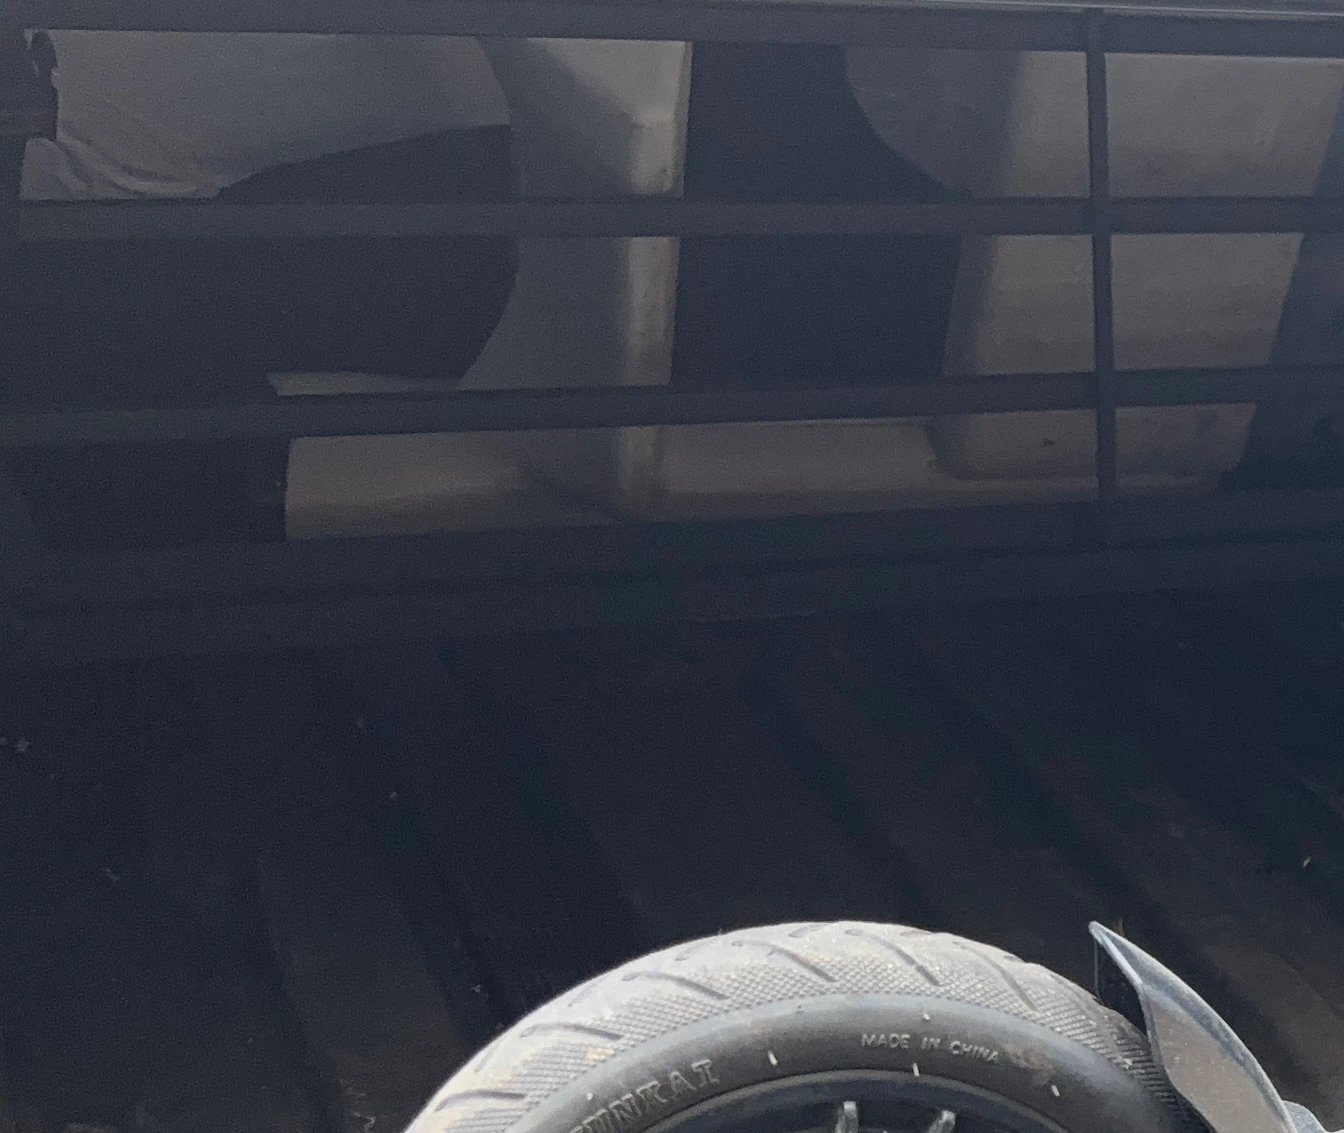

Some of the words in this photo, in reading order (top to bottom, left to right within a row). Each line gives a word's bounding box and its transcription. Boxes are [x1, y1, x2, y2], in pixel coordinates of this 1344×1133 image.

[861, 1033, 911, 1050] MADE
[919, 1036, 941, 1050] IN
[949, 1040, 999, 1063] CHINA
